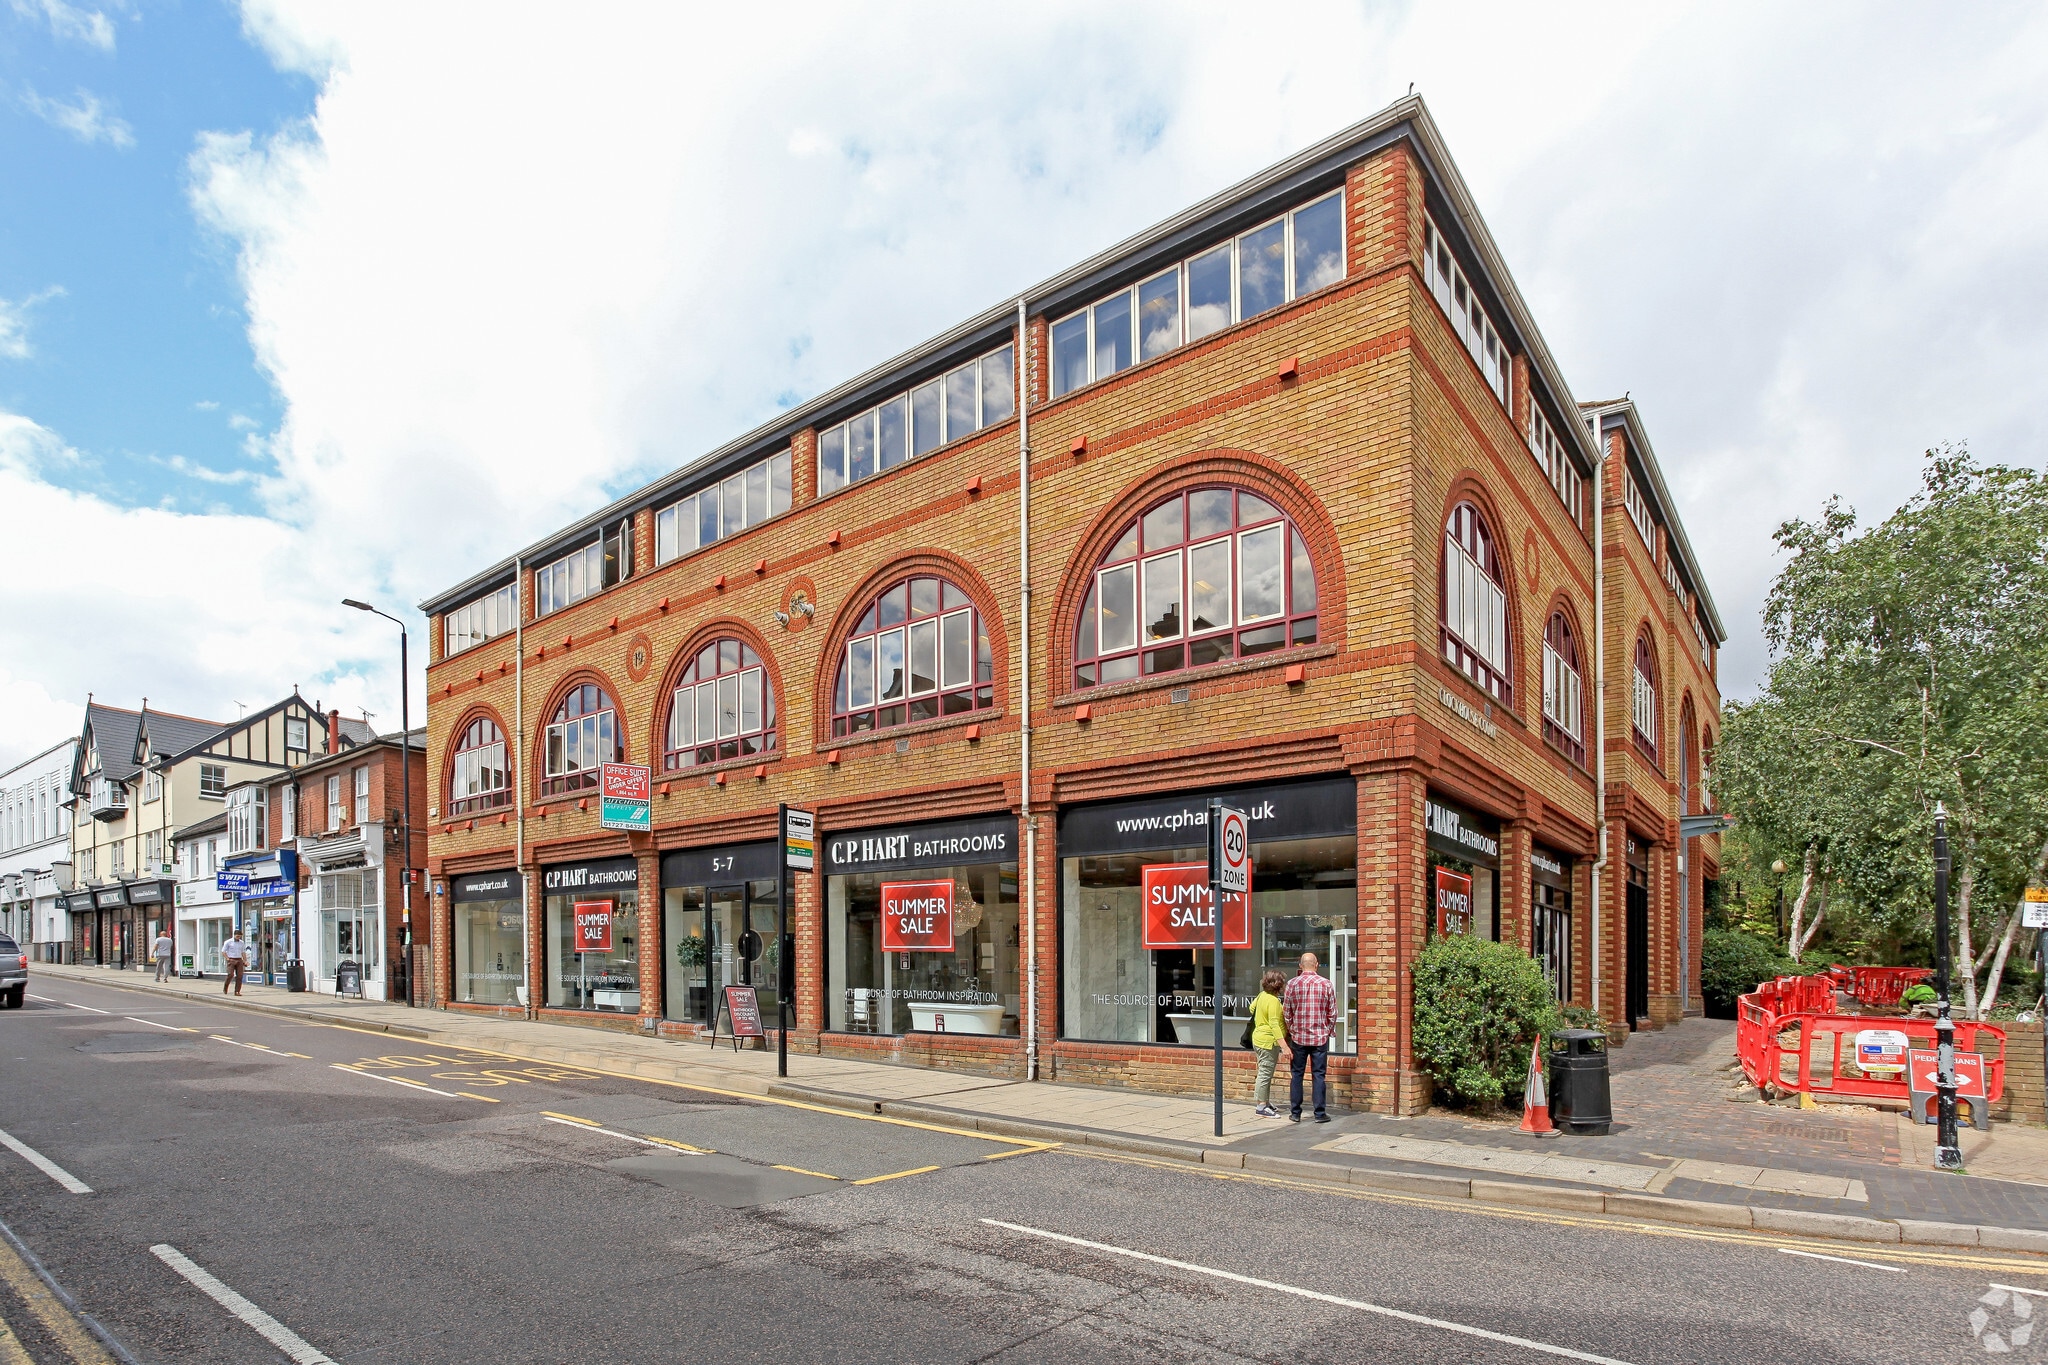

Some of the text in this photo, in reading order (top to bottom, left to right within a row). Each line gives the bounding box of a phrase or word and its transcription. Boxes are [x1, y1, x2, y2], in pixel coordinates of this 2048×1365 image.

[1479, 717, 1497, 738] COURT
[606, 767, 647, 777] OFFICE SUITE
[608, 776, 643, 790] UNDER OFFER
[605, 798, 648, 806] AITCHISON
[1117, 801, 1275, 832] www.cphar.uk
[1433, 804, 1460, 840] HART
[1459, 826, 1498, 857] BATHROOMS
[862, 835, 909, 861] HART
[914, 833, 1006, 857] BATHROOMS
[1227, 829, 1243, 852] 20
[713, 857, 734, 871] 5-7
[218, 873, 248, 881] SWIFT
[465, 878, 509, 893] www.cphart.co.uk
[562, 868, 588, 887] HART
[589, 869, 637, 885] BATHROOMS
[1224, 869, 1245, 886] ZONE
[1152, 884, 1240, 905] SUMM
[1439, 888, 1469, 914] SUMMER
[887, 898, 947, 915] SUMMER
[578, 913, 609, 926] SUMMER
[1171, 906, 1215, 927] SALE
[1445, 912, 1463, 934] SALE
[584, 927, 603, 939] SALE
[900, 917, 933, 934] SALE
[563, 974, 579, 982] SOURCE
[586, 975, 607, 984] BATHROOM
[608, 975, 635, 984] INSPIRATION
[864, 988, 889, 999] OURCE
[891, 989, 901, 999] OF
[903, 989, 945, 1000] BATHROOM
[946, 990, 998, 1002] INSPIRATION
[1091, 993, 1110, 1005] THE
[1113, 994, 1156, 1007] SOURCE
[1158, 995, 1171, 1007] OF
[352, 1053, 518, 1069] STOP
[1914, 1054, 1977, 1066] PEDEIANS
[431, 1067, 601, 1087] BUS
